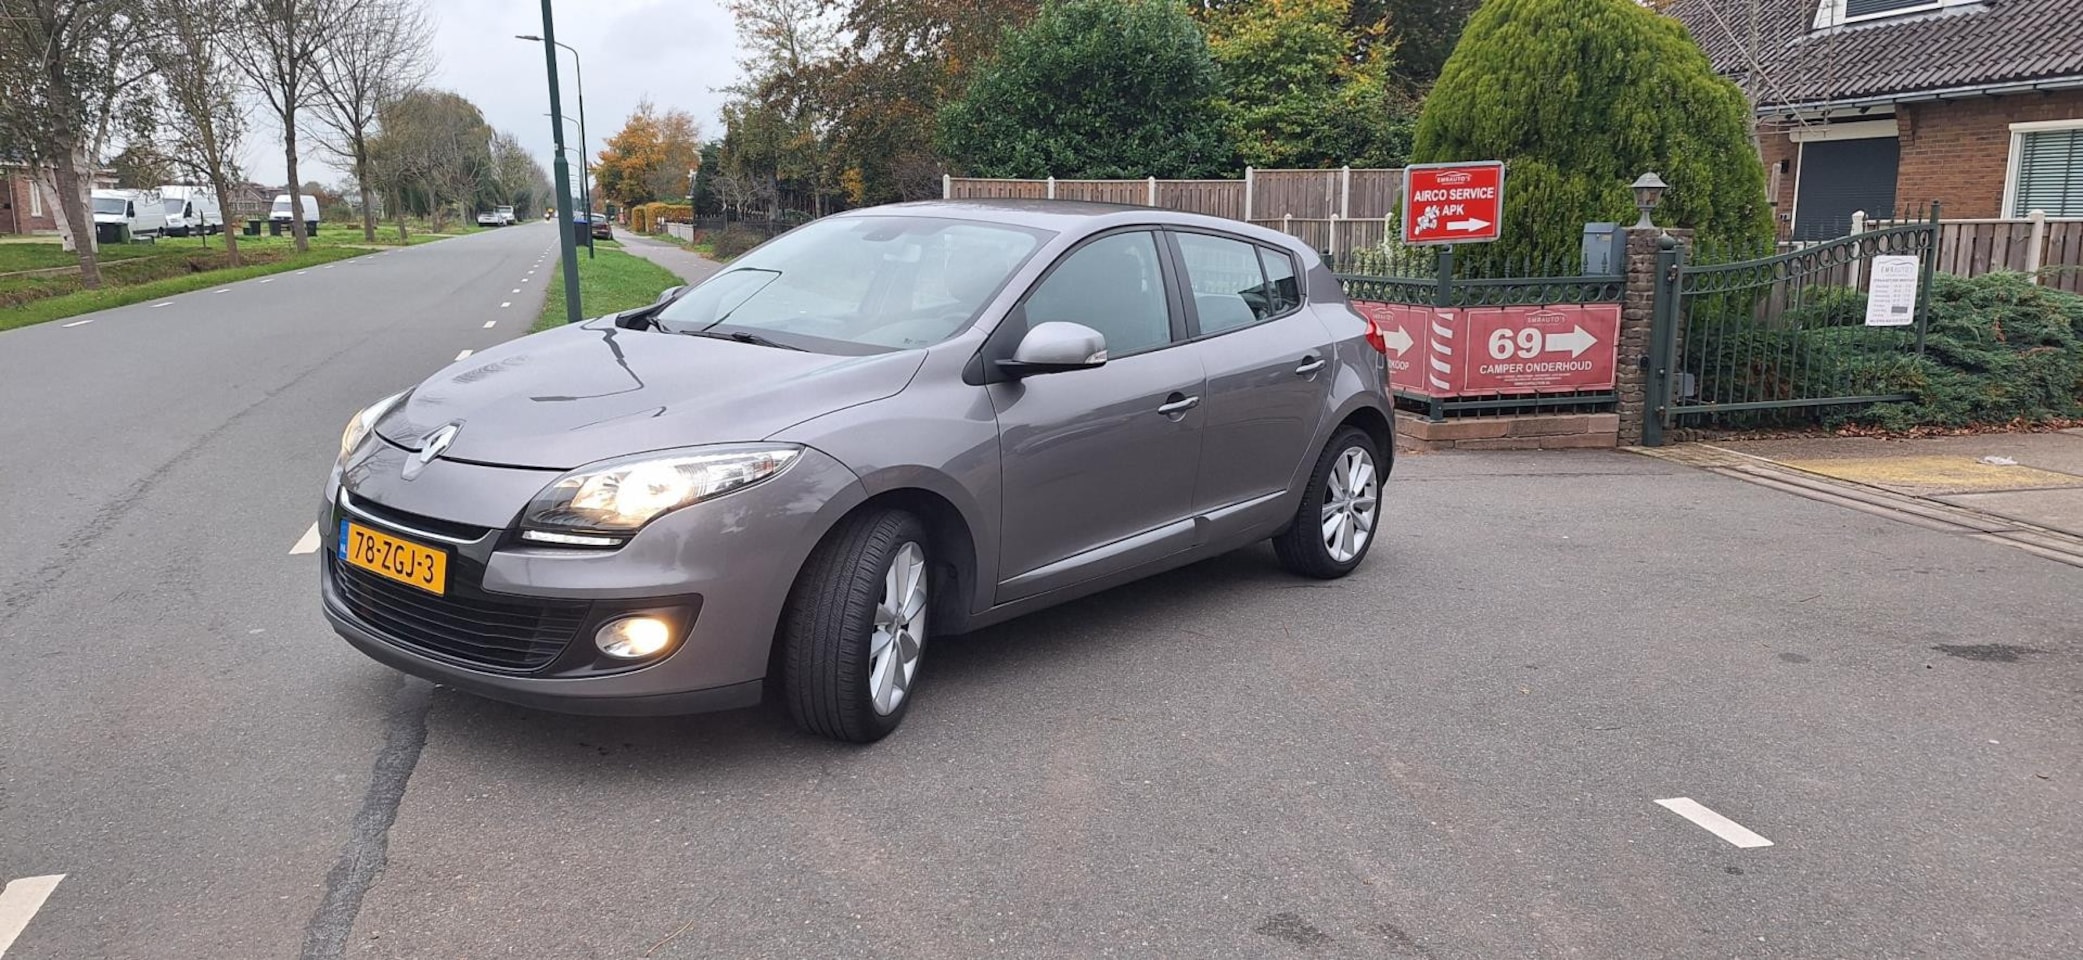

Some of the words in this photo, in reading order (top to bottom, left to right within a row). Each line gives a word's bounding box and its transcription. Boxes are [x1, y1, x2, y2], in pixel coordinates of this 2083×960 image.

[1413, 189, 1448, 202] AIRCO
[1449, 187, 1495, 200] SERVICE
[1441, 204, 1465, 216] APK
[1488, 327, 1543, 360] 69
[1479, 363, 1524, 375] CAMPER
[1525, 361, 1593, 374] ONDERHOUD
[355, 531, 434, 584] 78-ZGJ-3
